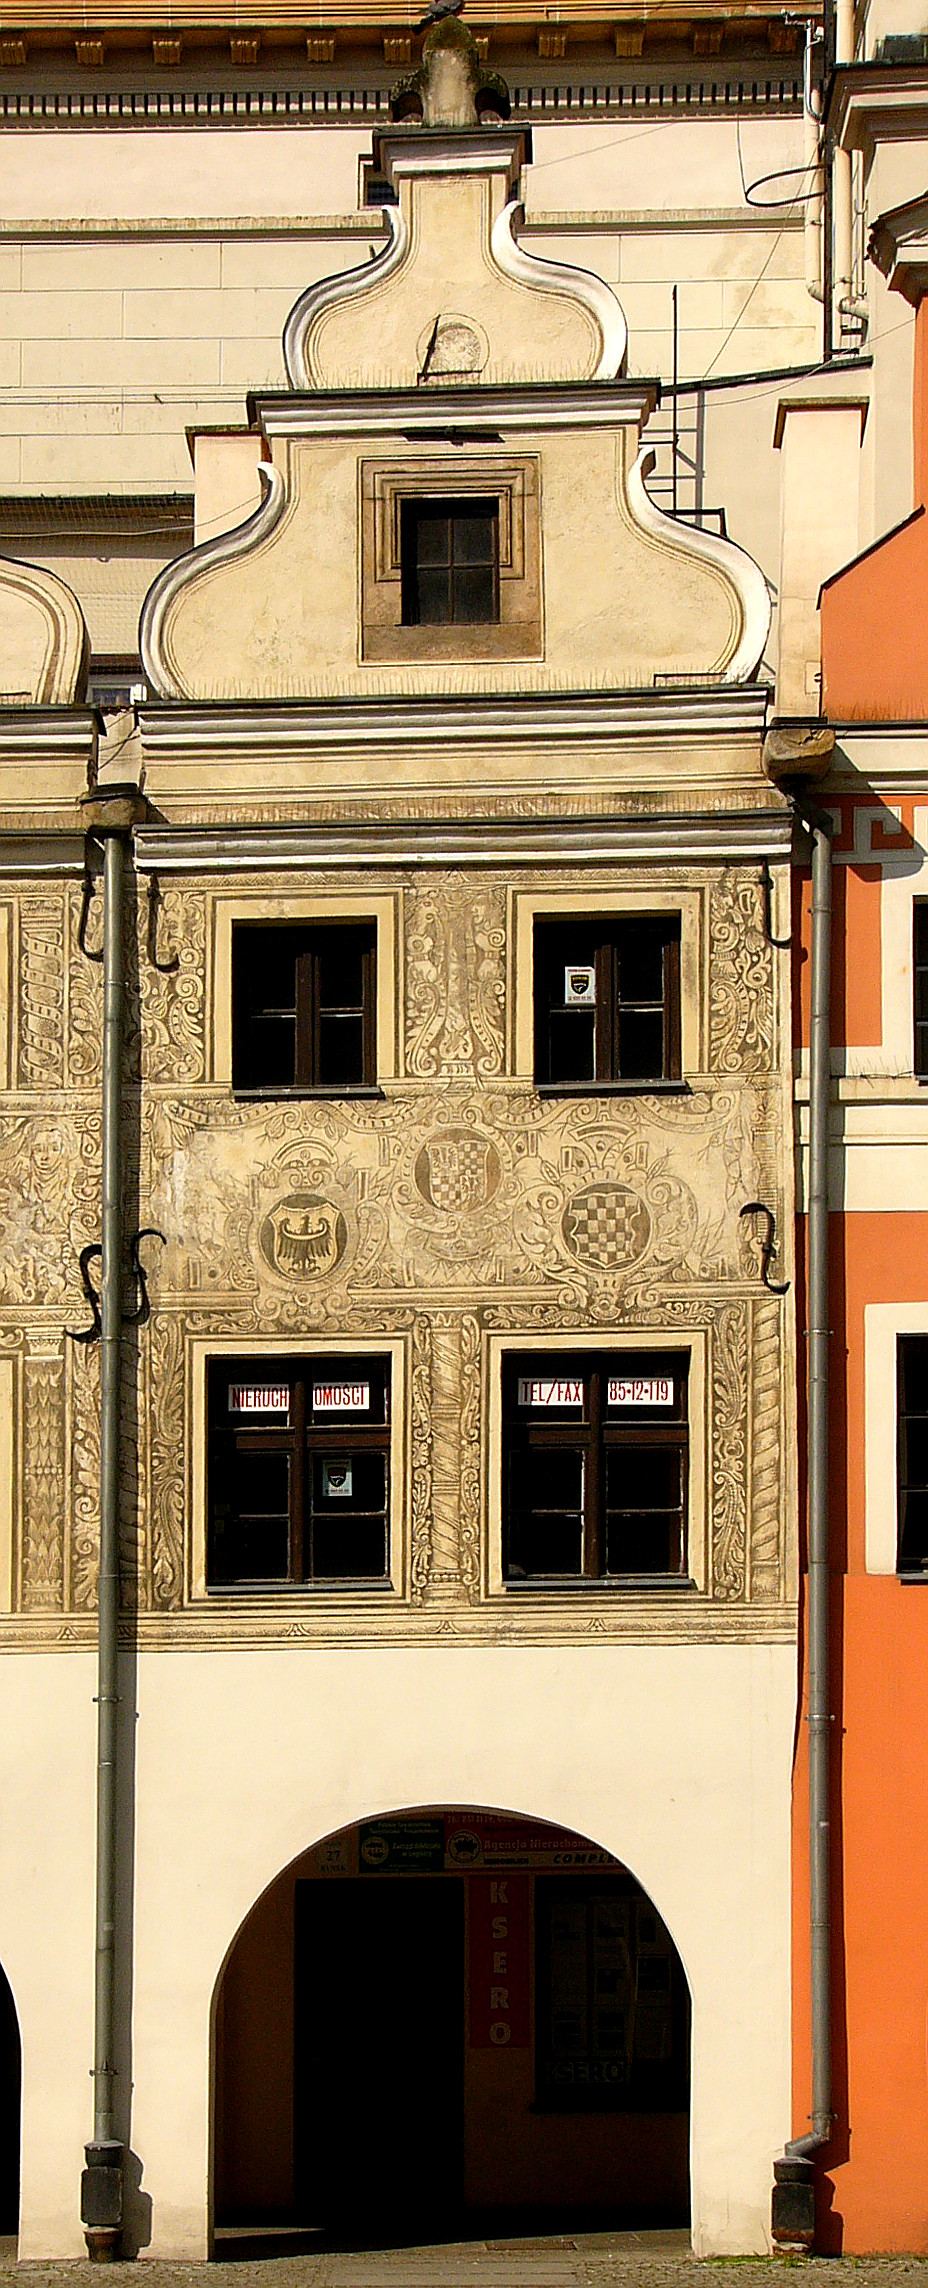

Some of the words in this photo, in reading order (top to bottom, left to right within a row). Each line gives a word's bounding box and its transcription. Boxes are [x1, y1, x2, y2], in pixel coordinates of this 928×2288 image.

[232, 1386, 289, 1408] NIERUCH
[314, 1383, 366, 1406] OMOŚCI
[522, 1379, 581, 1404] TEL/FAX
[489, 1881, 511, 2045] KSERO
